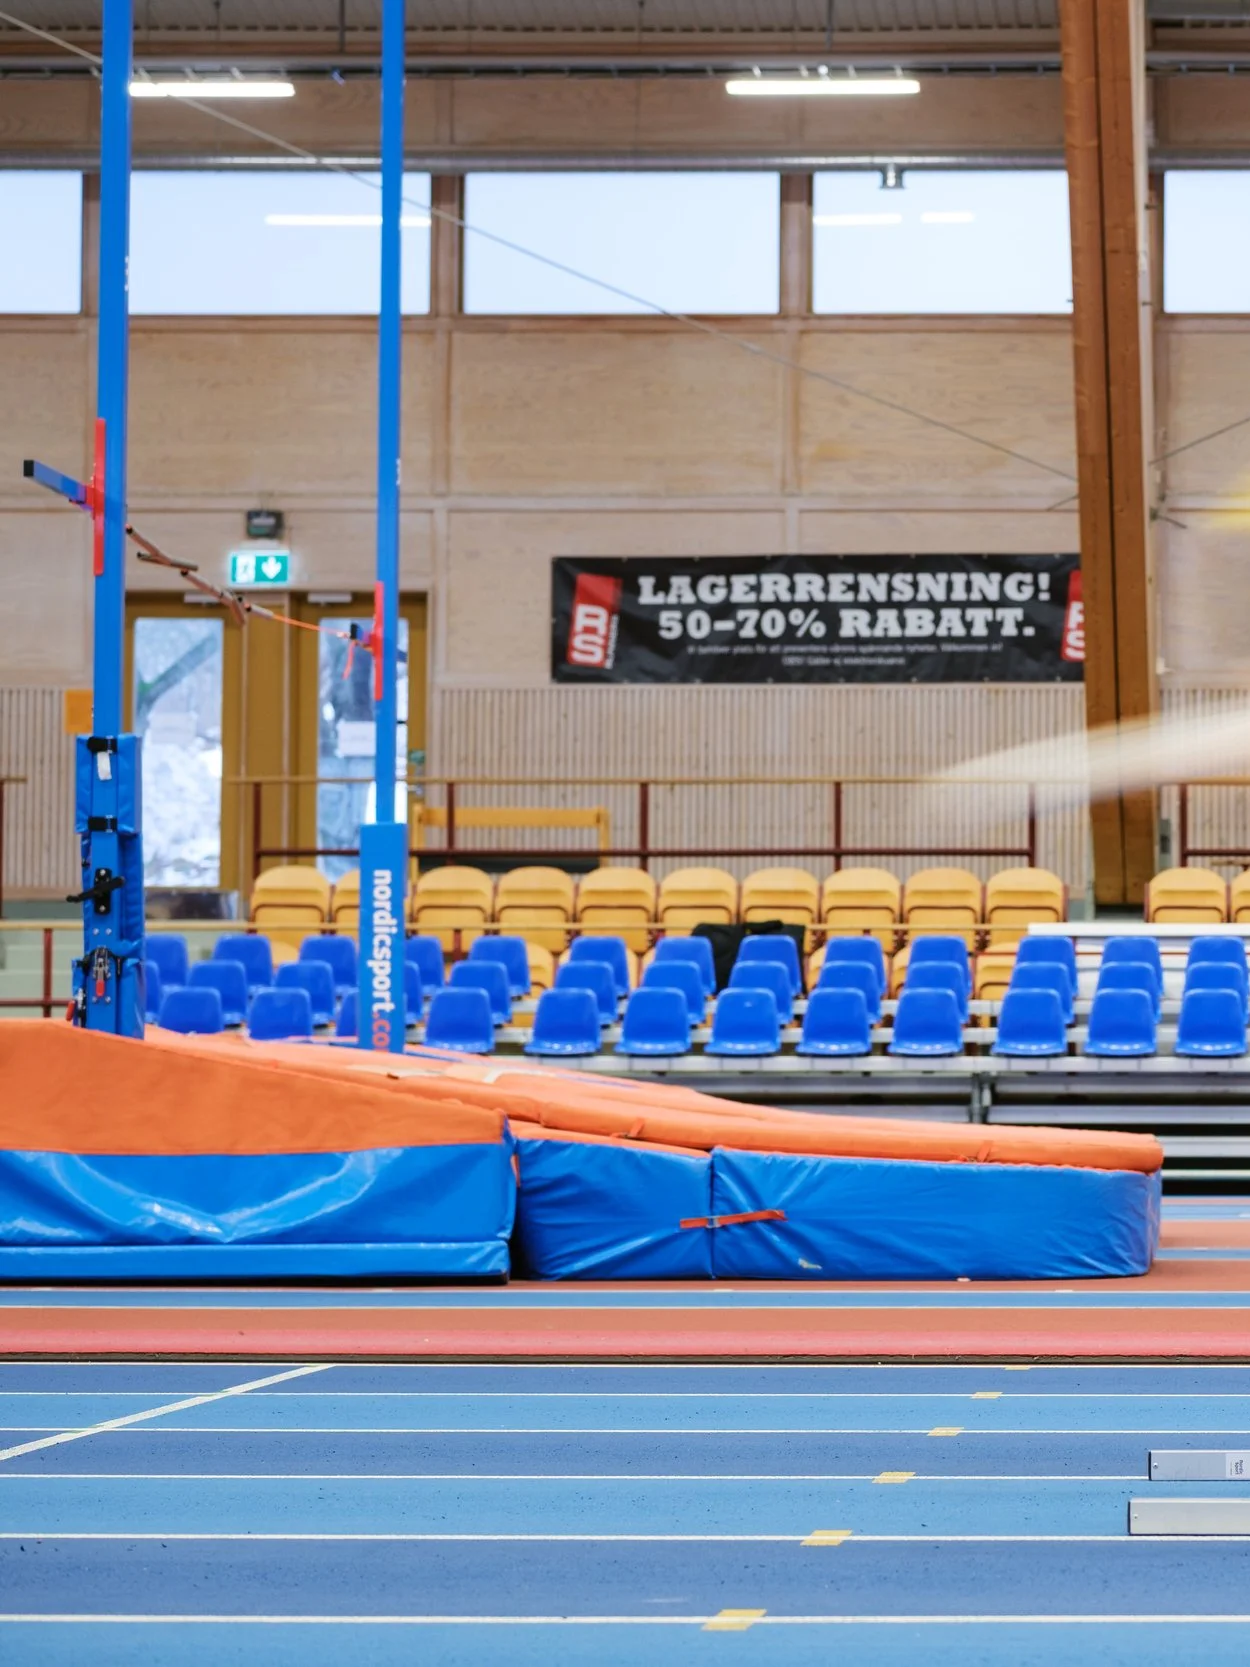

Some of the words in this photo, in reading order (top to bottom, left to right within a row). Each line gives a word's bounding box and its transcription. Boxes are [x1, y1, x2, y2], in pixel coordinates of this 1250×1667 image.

[637, 572, 1050, 604] LAGERRENSNING!
[571, 603, 608, 665] RS
[658, 608, 827, 640] 50-70%
[838, 607, 1036, 638] RABATT.
[367, 869, 398, 1052] nordicsport.co
